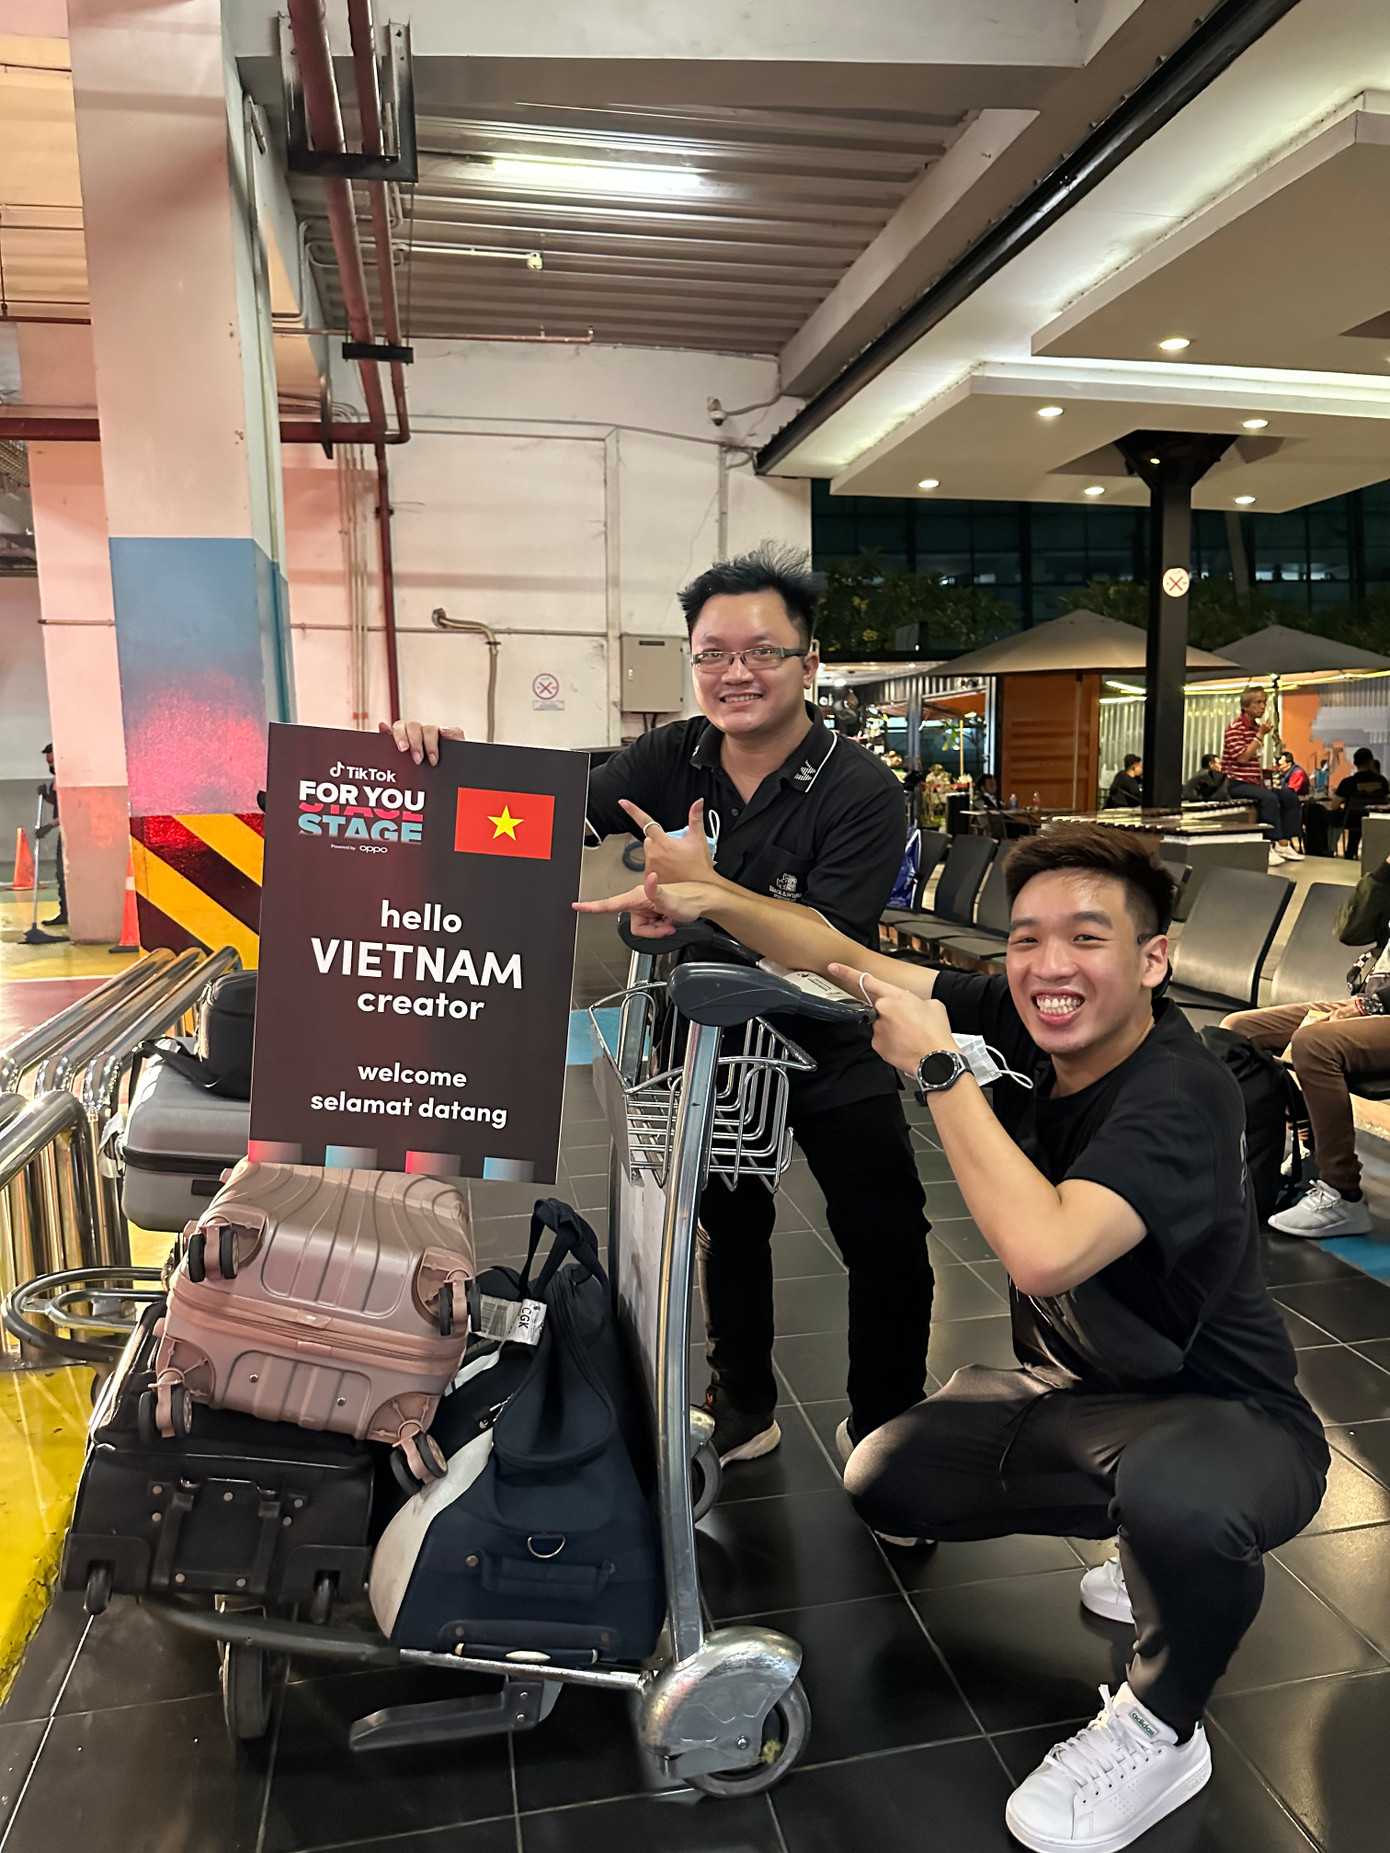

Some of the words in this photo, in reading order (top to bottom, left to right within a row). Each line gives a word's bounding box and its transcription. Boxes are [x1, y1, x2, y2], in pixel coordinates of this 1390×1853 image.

[346, 765, 397, 783] TikTok
[298, 780, 359, 806] FOR
[362, 786, 426, 811] YOU
[298, 813, 424, 845] STAGE
[380, 899, 463, 933] hello
[310, 937, 523, 990] VIETNAM
[357, 992, 485, 1020] creator
[357, 1062, 468, 1088] welcome
[310, 1090, 413, 1116] selamat
[418, 1097, 508, 1130] datang
[518, 1307, 532, 1329] CGK
[1131, 1711, 1156, 1737] adidas
